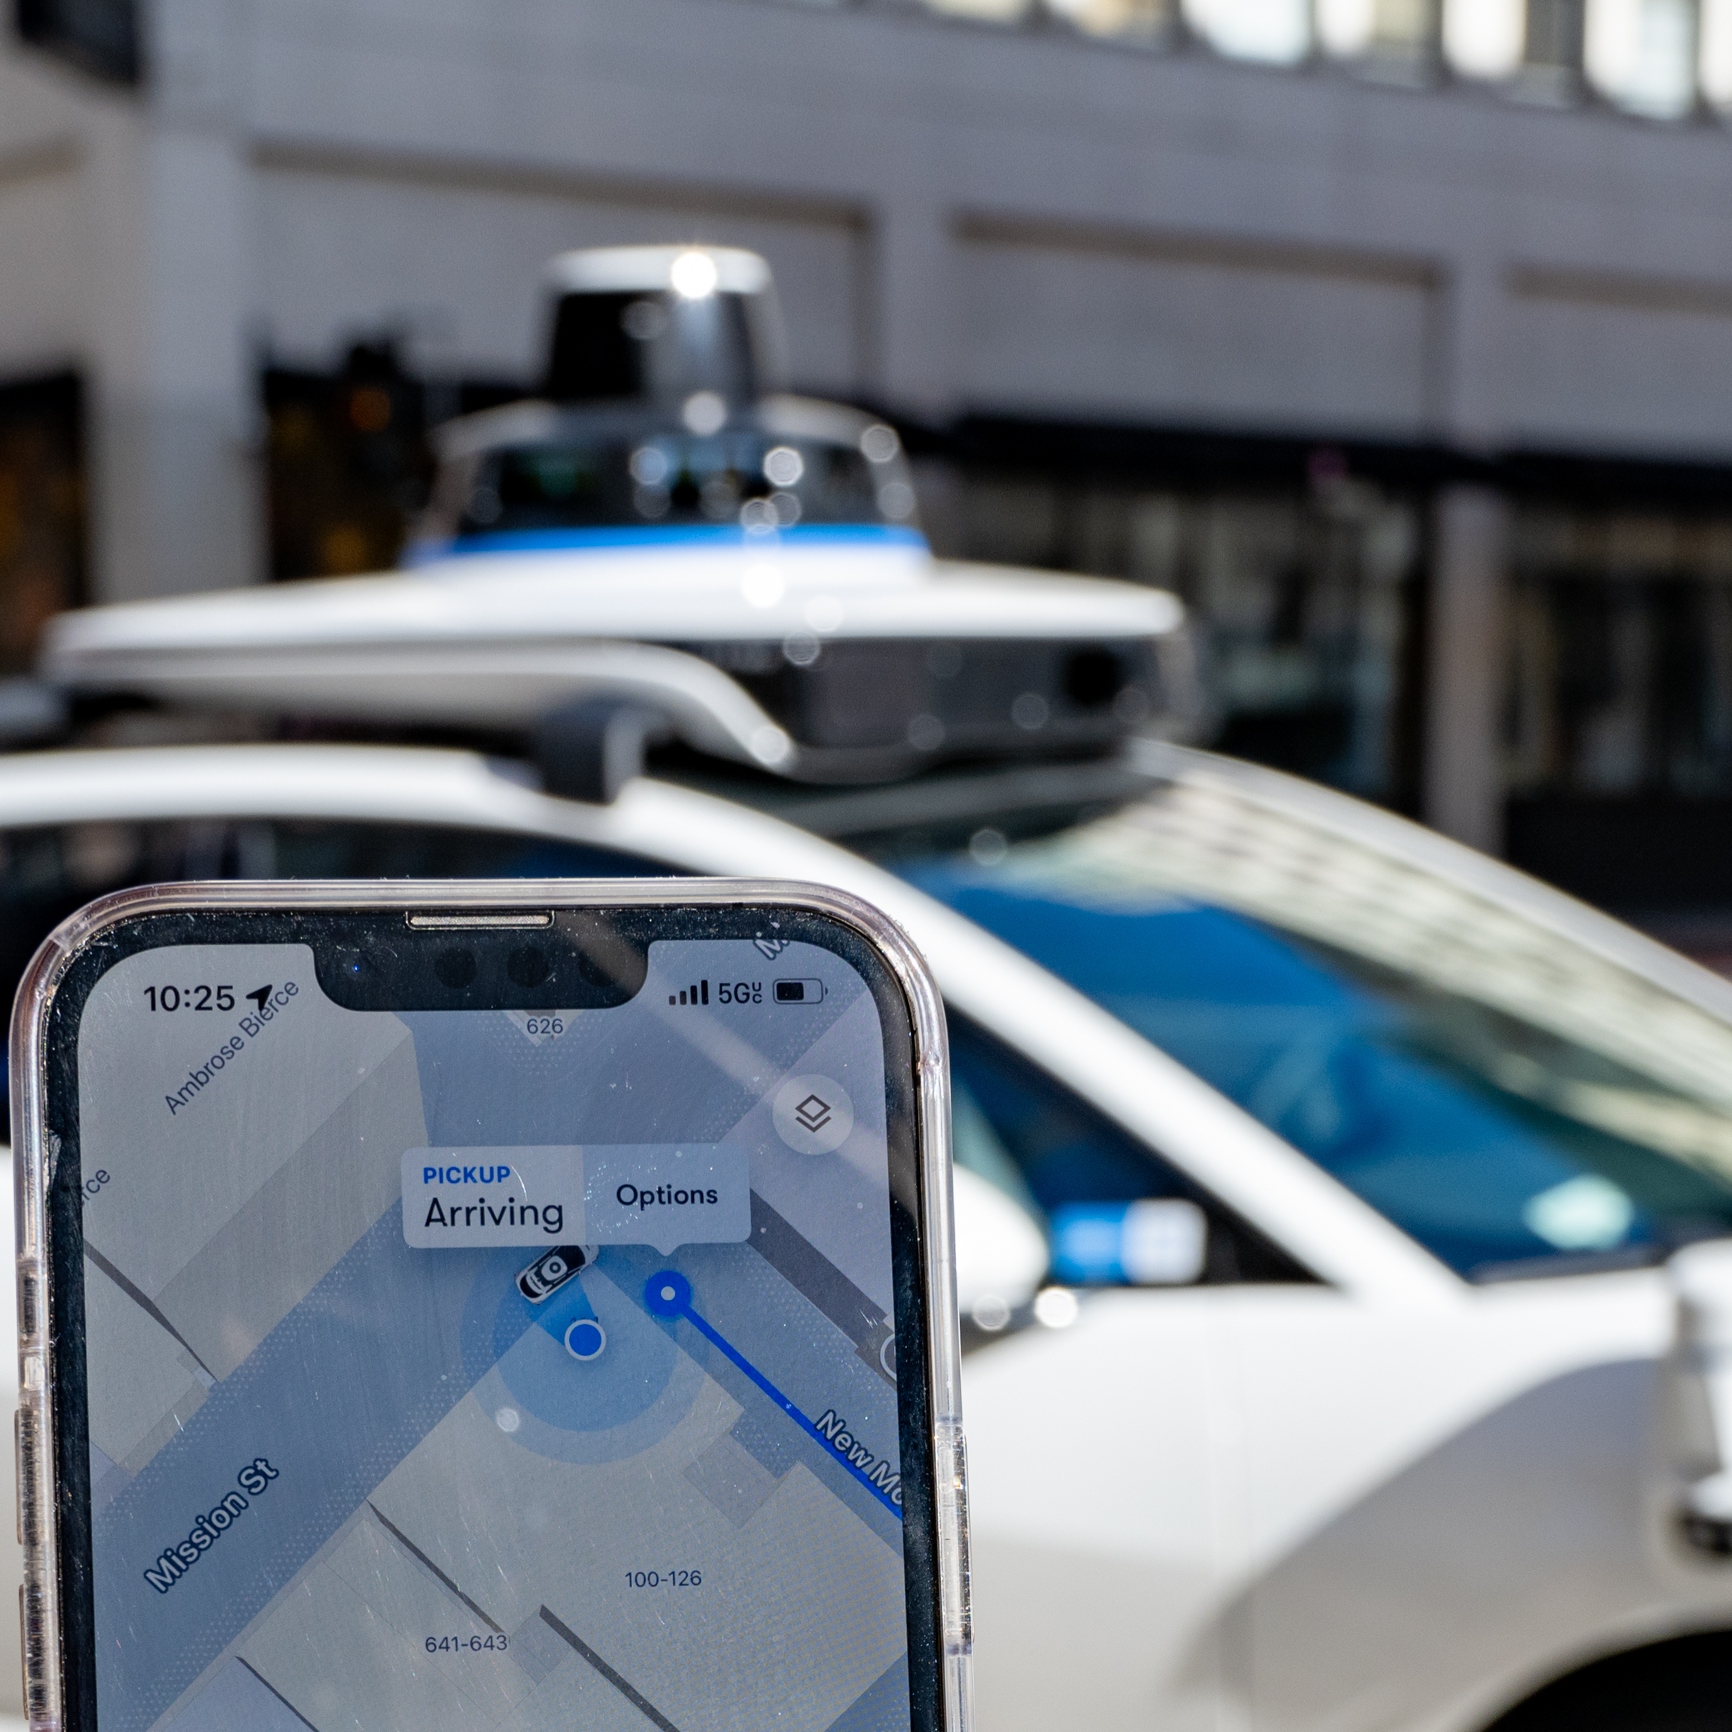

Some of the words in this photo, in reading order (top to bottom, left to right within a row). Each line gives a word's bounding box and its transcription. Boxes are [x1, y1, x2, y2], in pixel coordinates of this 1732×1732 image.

[143, 984, 236, 1012] 10:25
[526, 1018, 564, 1035] 626
[164, 1035, 245, 1116] Ambrose
[238, 981, 299, 1039] Bierce
[80, 1168, 111, 1207] rce
[423, 1165, 511, 1185] PICKUP
[616, 1183, 718, 1212] Options
[424, 1196, 564, 1235] Arriving
[814, 1409, 875, 1471] New
[144, 1491, 249, 1594] Mission
[237, 1458, 279, 1495] St
[625, 1569, 702, 1588] 100-126
[425, 1634, 508, 1653] 641-643
